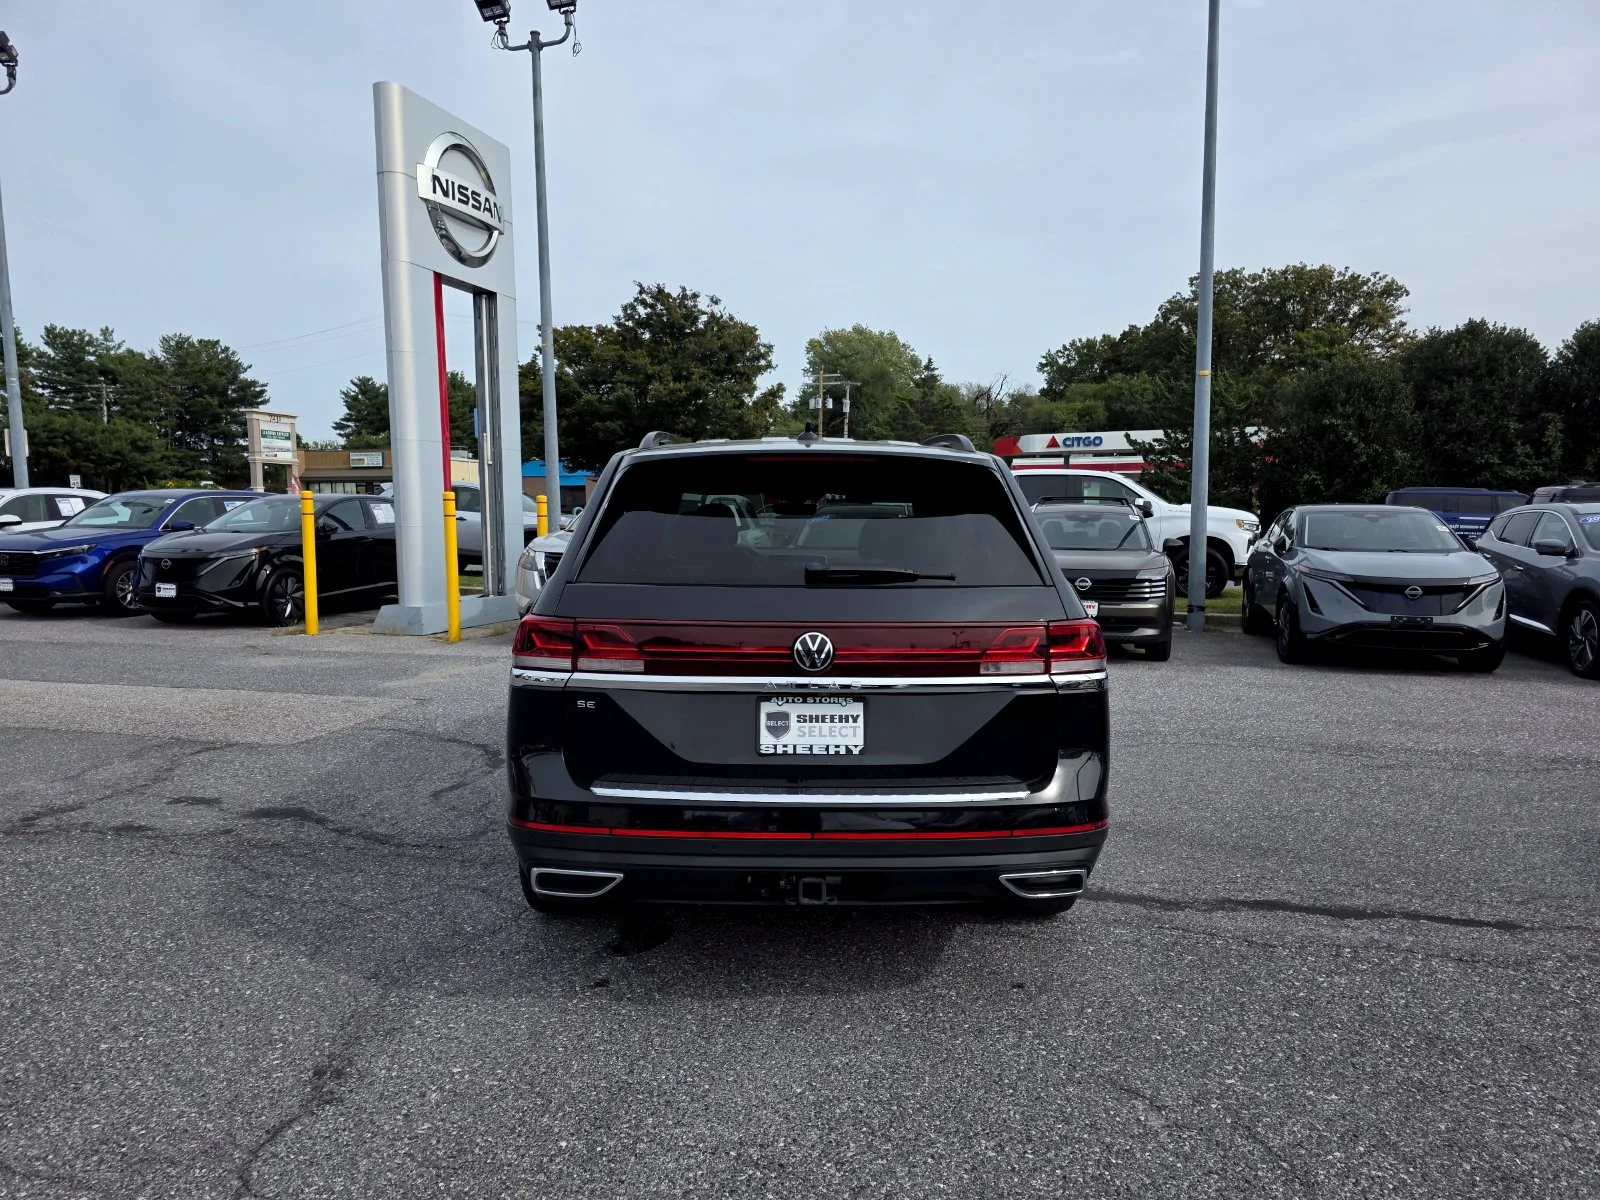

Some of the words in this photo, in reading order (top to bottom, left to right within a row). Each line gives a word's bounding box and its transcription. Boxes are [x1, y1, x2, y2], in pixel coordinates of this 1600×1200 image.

[432, 174, 502, 223] NISSAN
[1062, 435, 1103, 448] CITGO
[577, 700, 596, 709] SE
[770, 696, 803, 704] AUTO
[806, 697, 854, 705] STORES
[796, 714, 861, 724] SHEEHY
[797, 725, 861, 738] SELECT
[759, 744, 864, 754] SHEEHY
